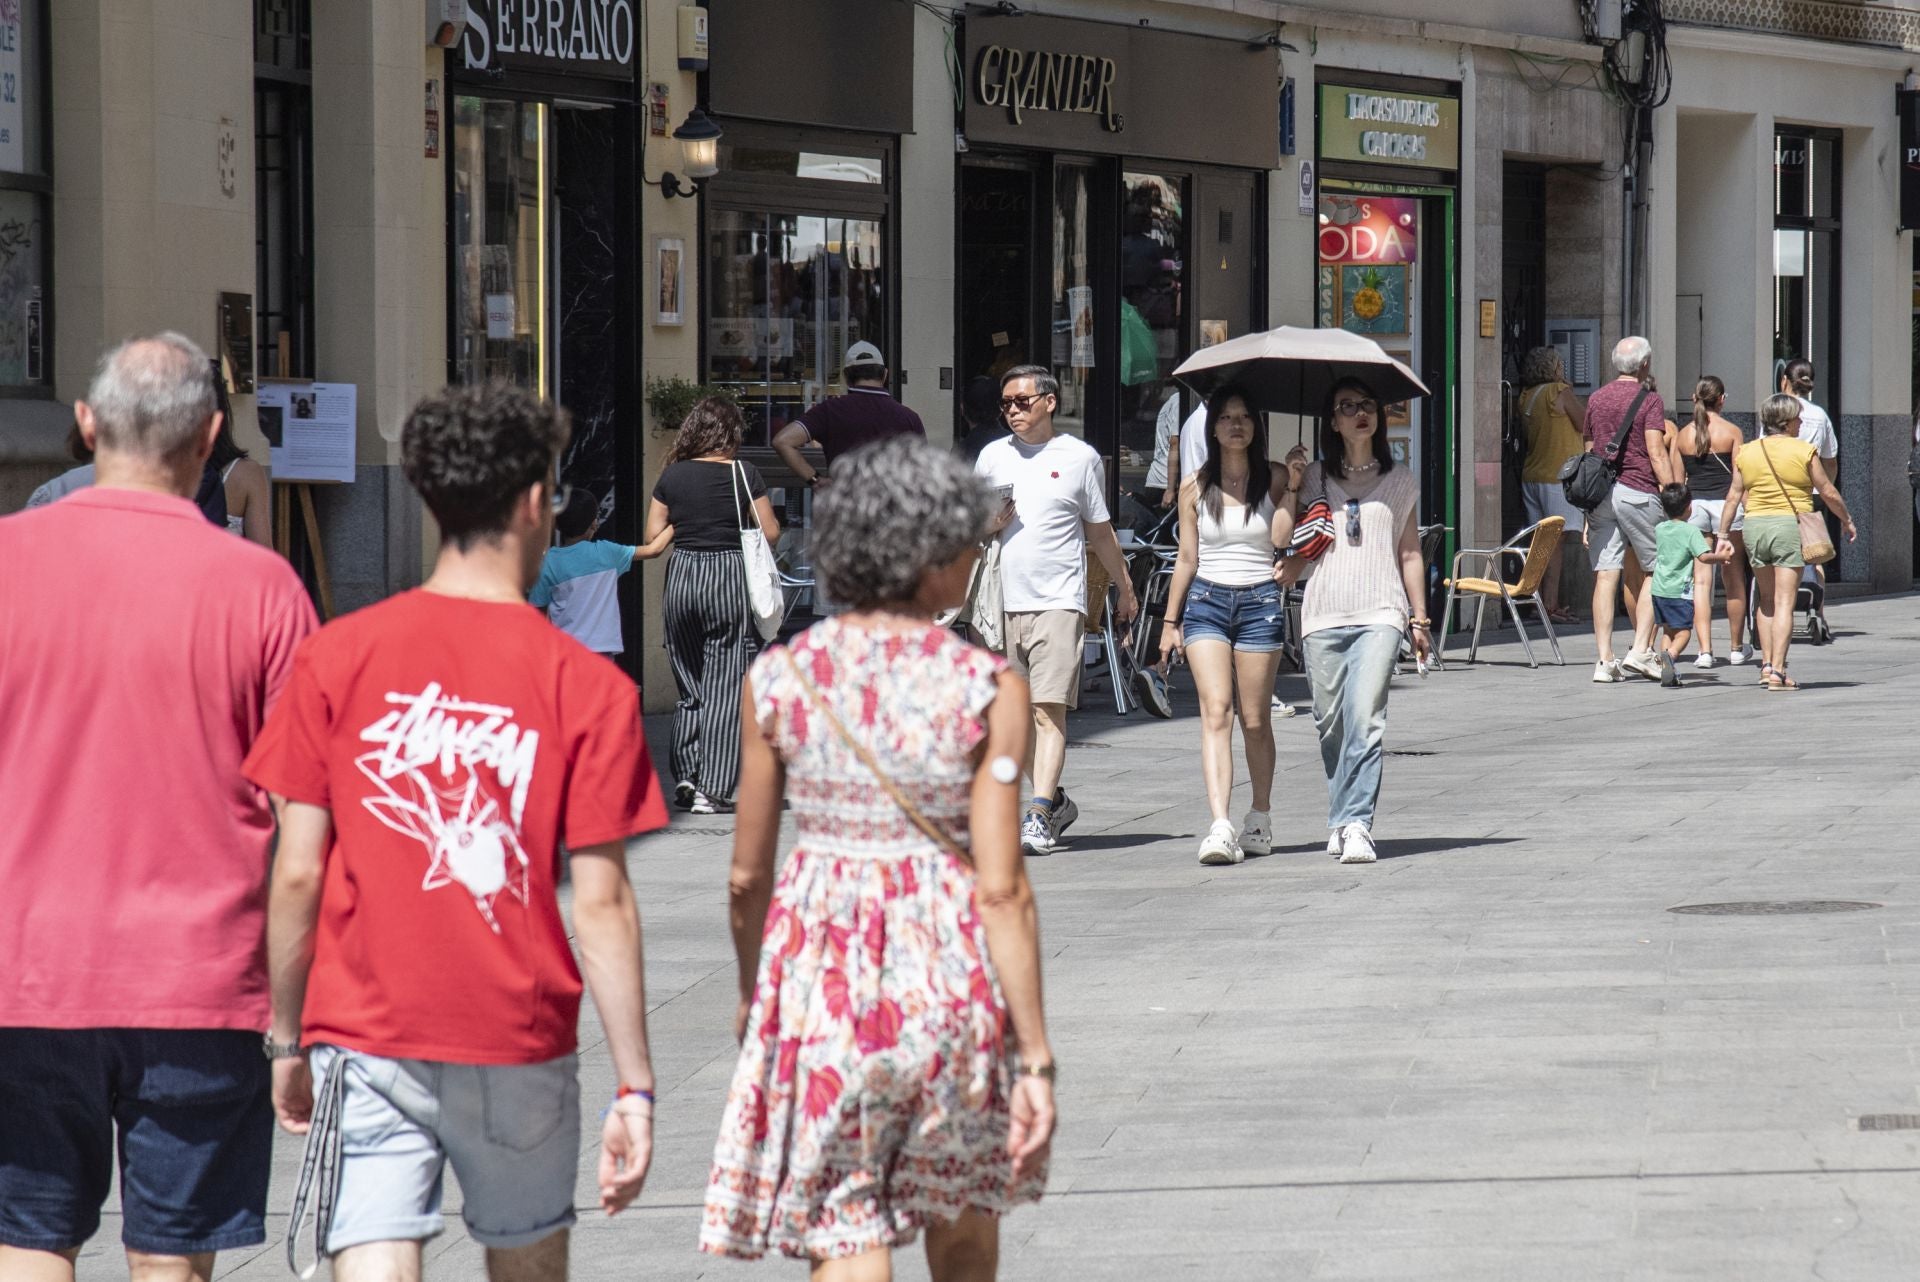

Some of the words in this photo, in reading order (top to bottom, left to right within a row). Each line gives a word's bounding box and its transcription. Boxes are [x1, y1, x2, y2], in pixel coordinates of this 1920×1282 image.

[0, 25, 15, 52] LE
[464, 0, 634, 70] SERRANO
[980, 44, 1117, 132] GRANIER
